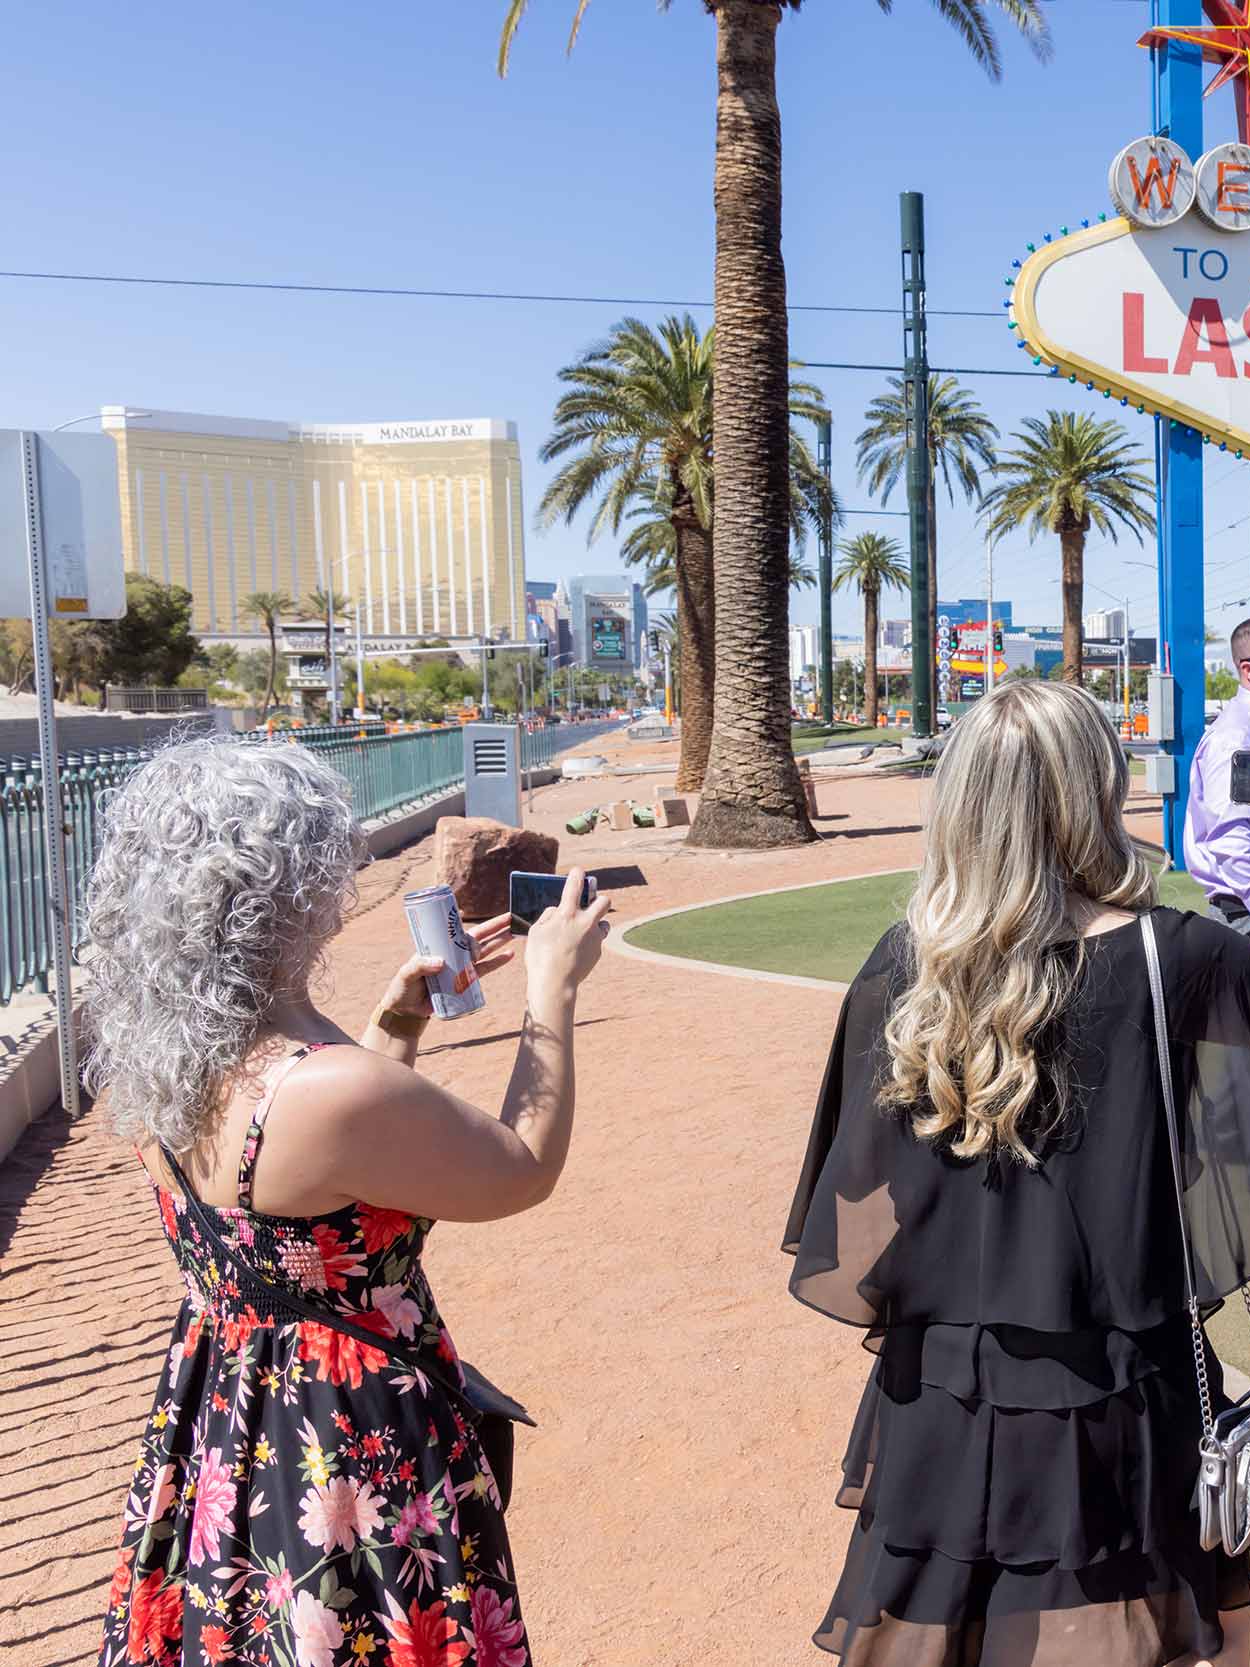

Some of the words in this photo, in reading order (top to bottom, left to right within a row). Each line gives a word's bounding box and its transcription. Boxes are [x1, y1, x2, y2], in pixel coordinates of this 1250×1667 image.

[1173, 247, 1229, 281] TO
[380, 425, 448, 440] MANDALAY
[451, 424, 473, 436] BAY
